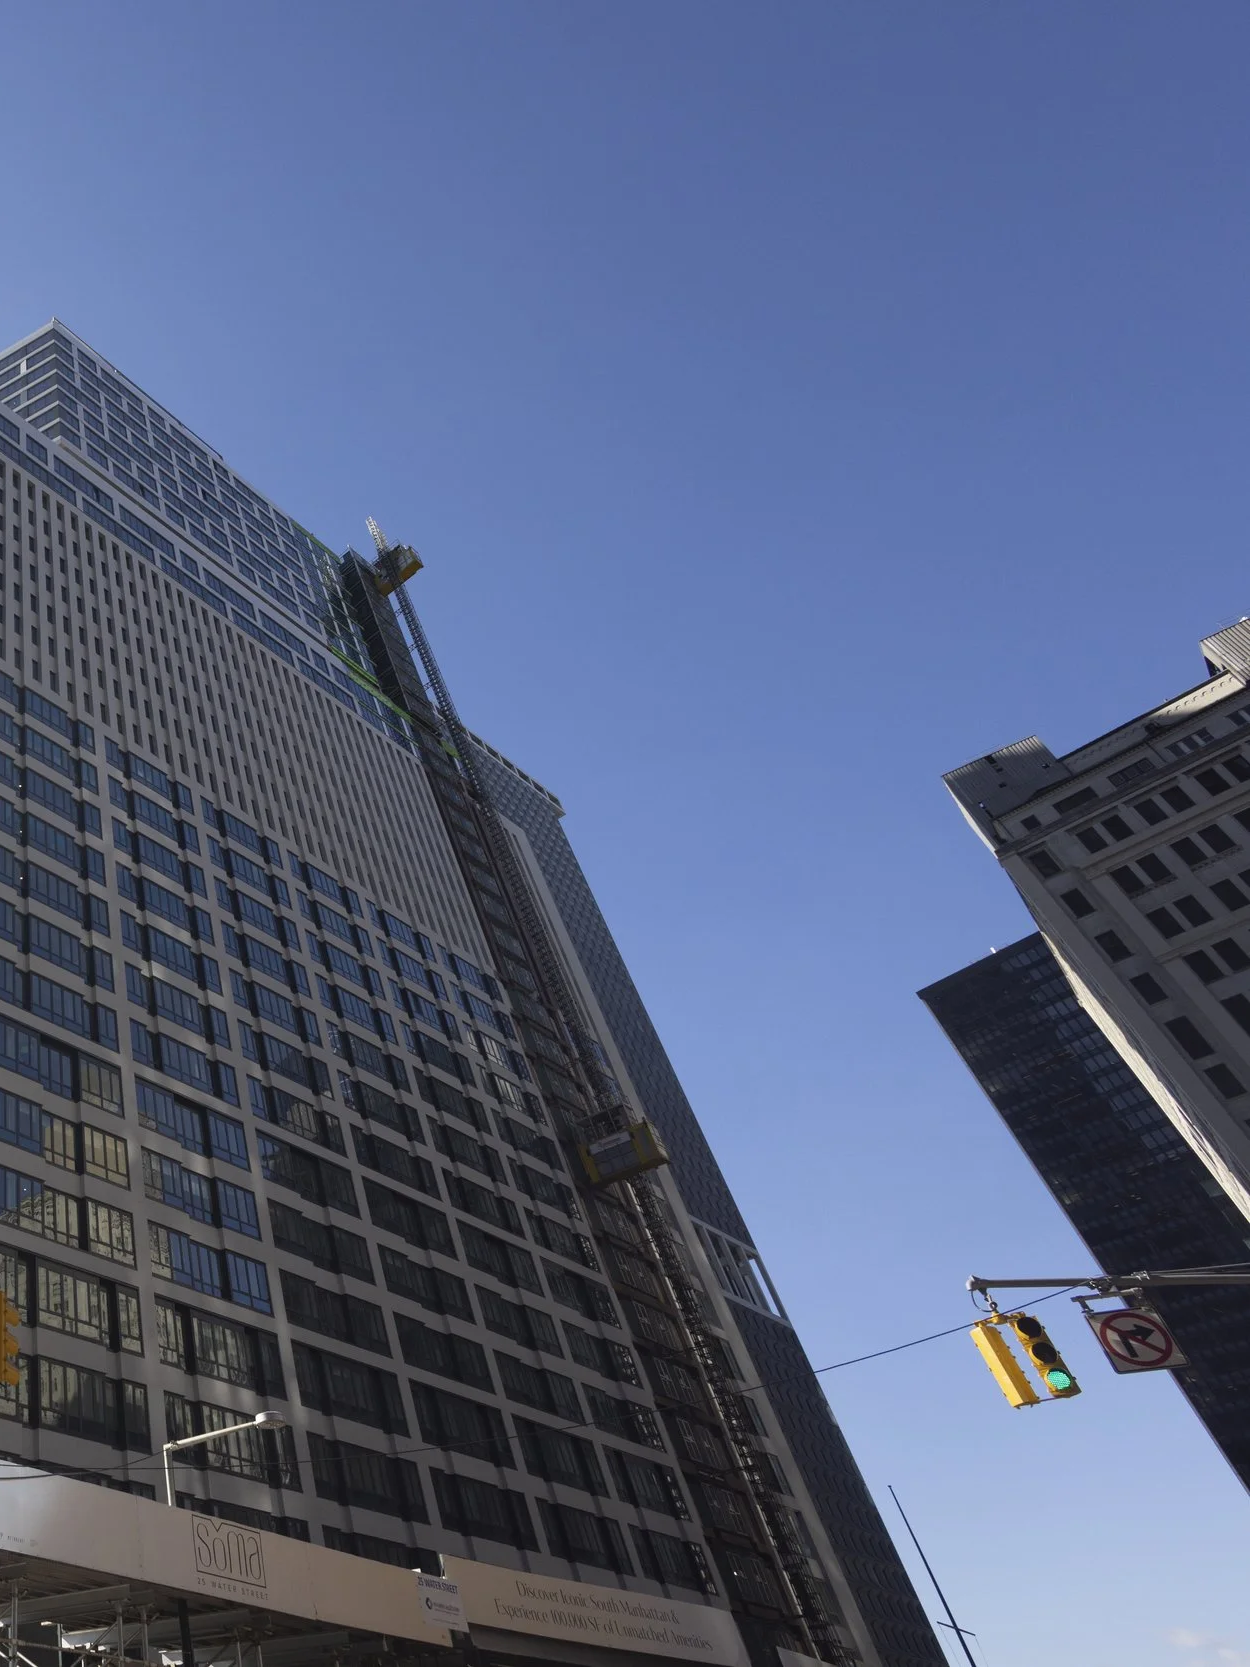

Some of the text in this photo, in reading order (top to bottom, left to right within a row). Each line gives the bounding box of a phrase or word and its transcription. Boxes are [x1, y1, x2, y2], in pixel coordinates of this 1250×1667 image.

[197, 1577, 270, 1601] 25 WATER STREET
[424, 1578, 442, 1591] WATER
[441, 1582, 459, 1595] STREET
[515, 1579, 680, 1625] Discover Iconic South Manhattan &
[493, 1597, 549, 1624] Experience
[550, 1608, 588, 1630] 100,000
[603, 1617, 614, 1634] of
[613, 1619, 670, 1644] Unmatched
[671, 1629, 714, 1652] Amenities
